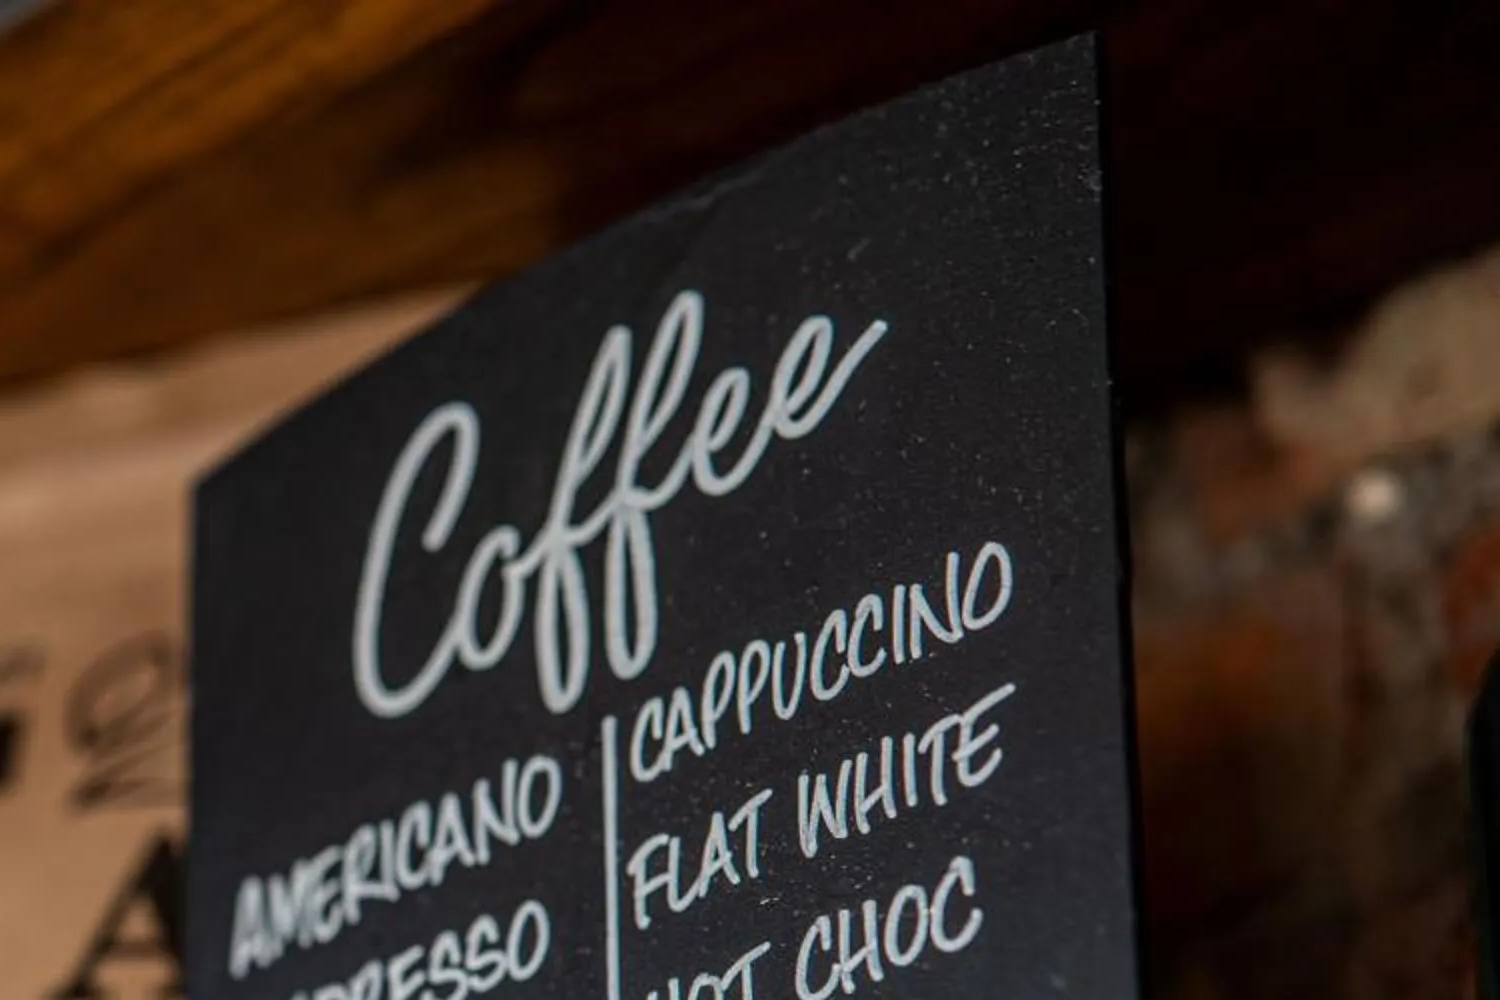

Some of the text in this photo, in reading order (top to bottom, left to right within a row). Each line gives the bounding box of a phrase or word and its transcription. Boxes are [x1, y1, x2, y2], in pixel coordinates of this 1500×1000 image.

[353, 290, 888, 719] Coffee
[630, 541, 1014, 782] CAPPUCCINO
[229, 755, 562, 979] AMERICANO
[627, 683, 1016, 929] FLAT WHITE
